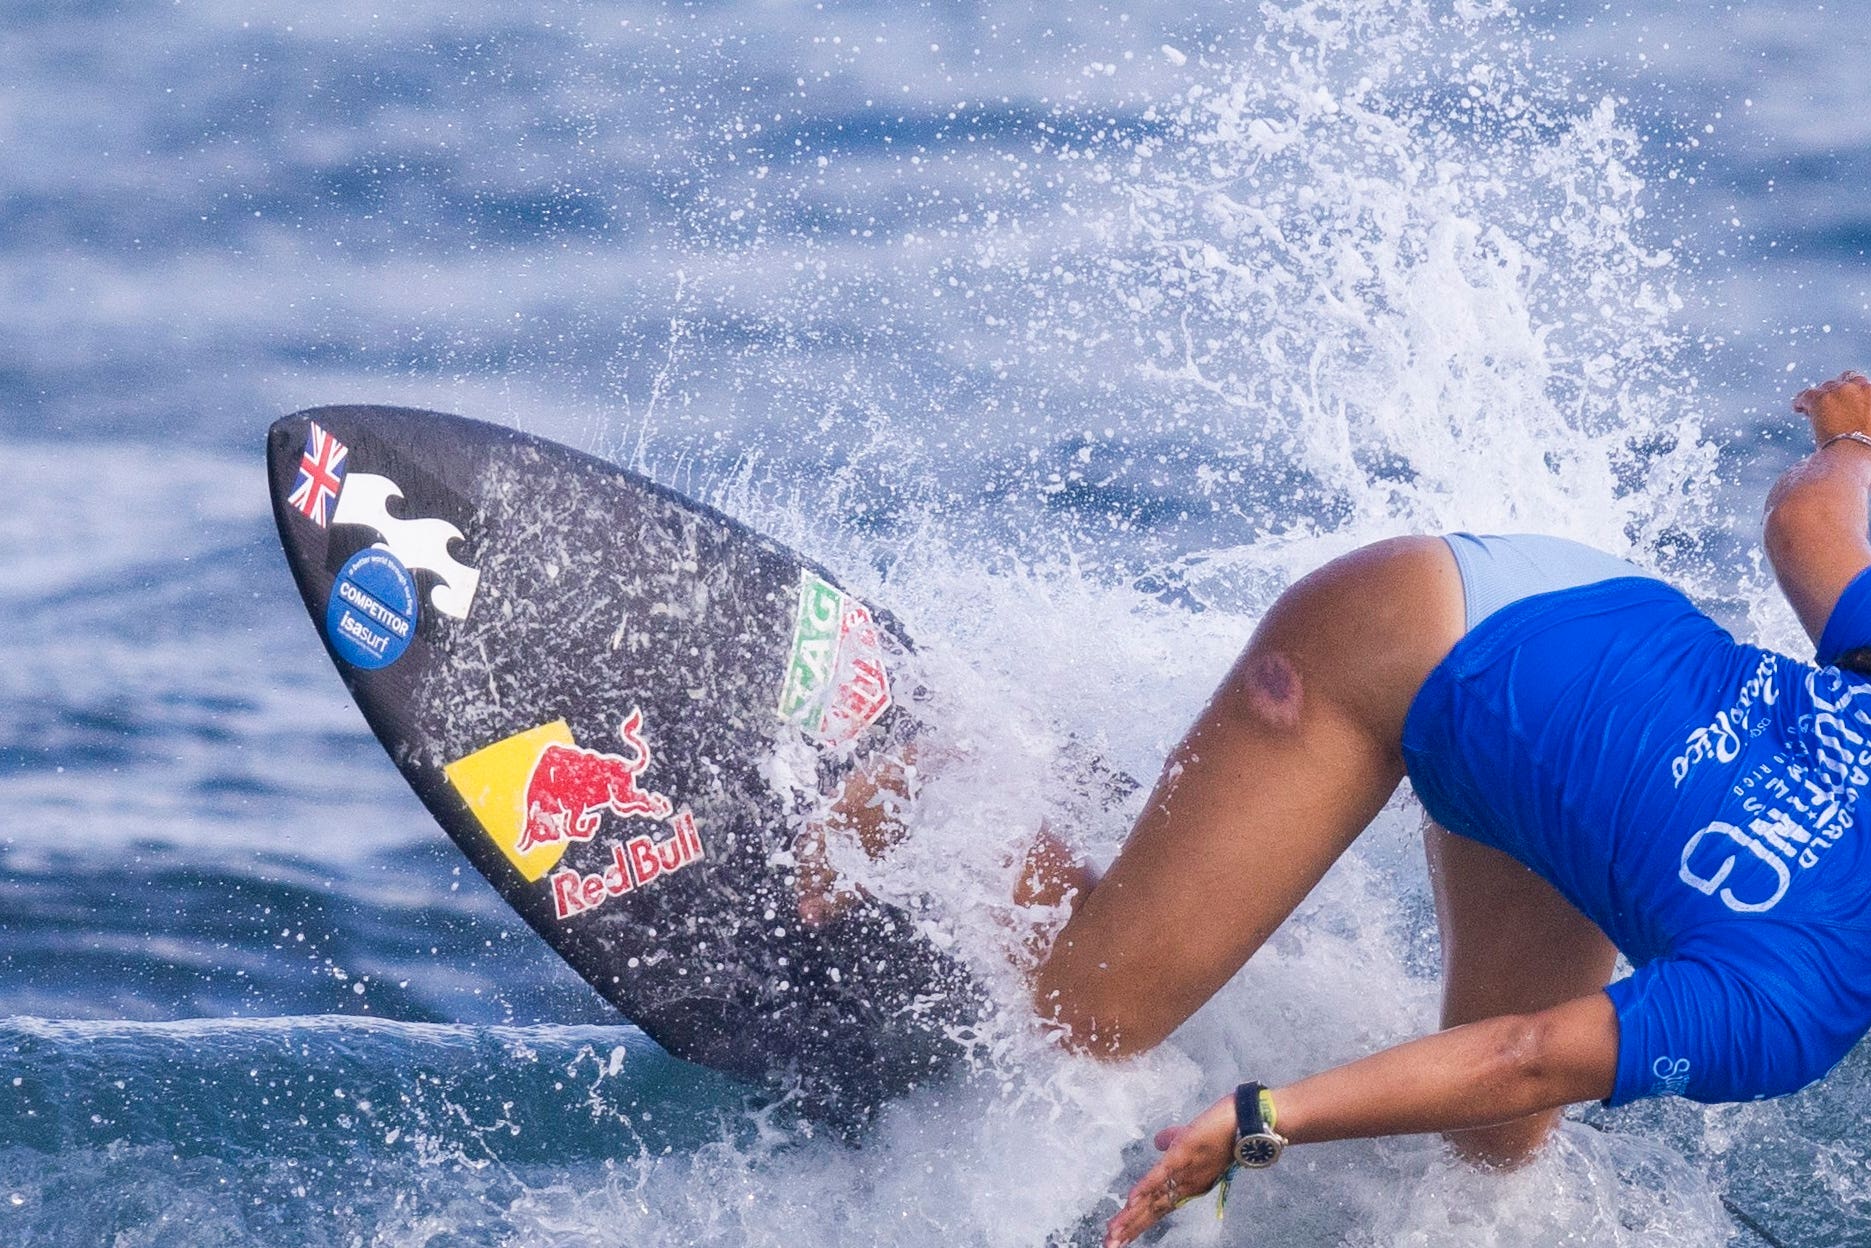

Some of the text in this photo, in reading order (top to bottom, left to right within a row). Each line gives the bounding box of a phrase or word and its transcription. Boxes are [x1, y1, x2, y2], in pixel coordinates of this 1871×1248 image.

[340, 581, 409, 637] COMPETITOR
[340, 610, 390, 652] isasurf
[788, 589, 836, 709] TAG
[1671, 709, 1741, 790] Rico
[551, 811, 703, 918] Red Bull
